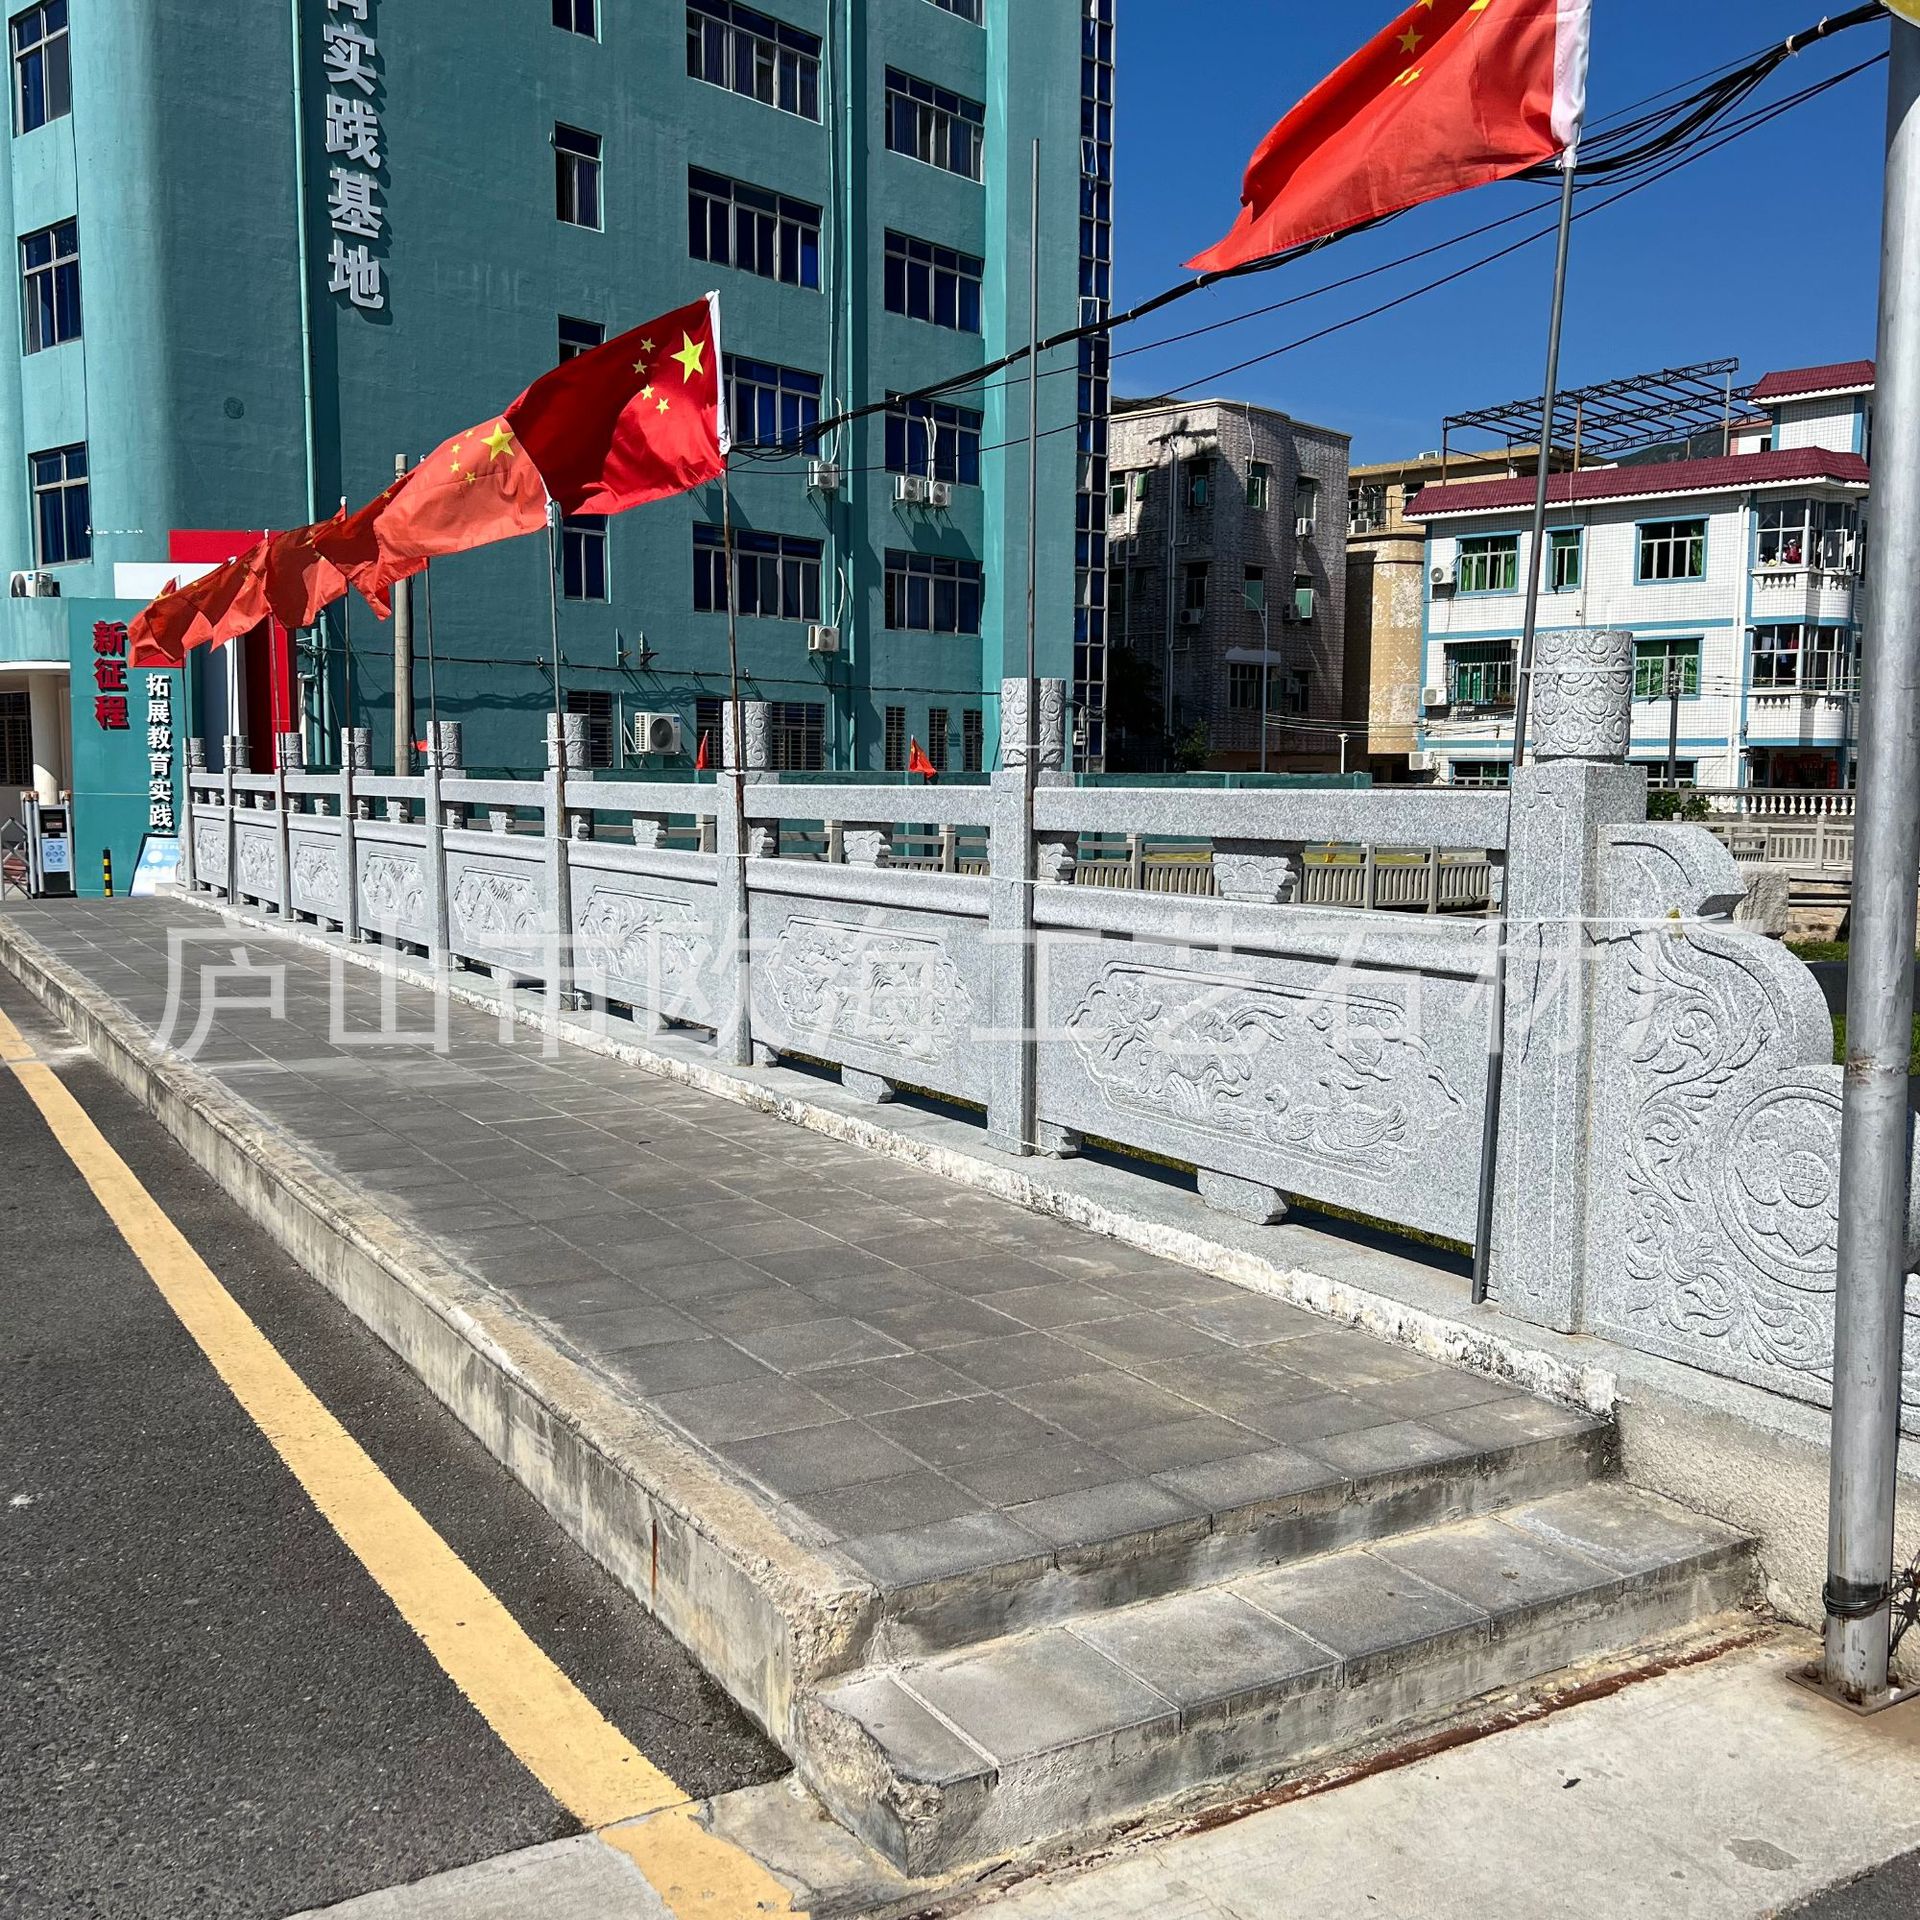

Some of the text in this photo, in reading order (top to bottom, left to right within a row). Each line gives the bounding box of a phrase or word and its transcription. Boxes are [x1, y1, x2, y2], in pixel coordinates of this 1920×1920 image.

[92, 620, 129, 730] 新征程
[146, 672, 173, 834] 拓展教育实践
